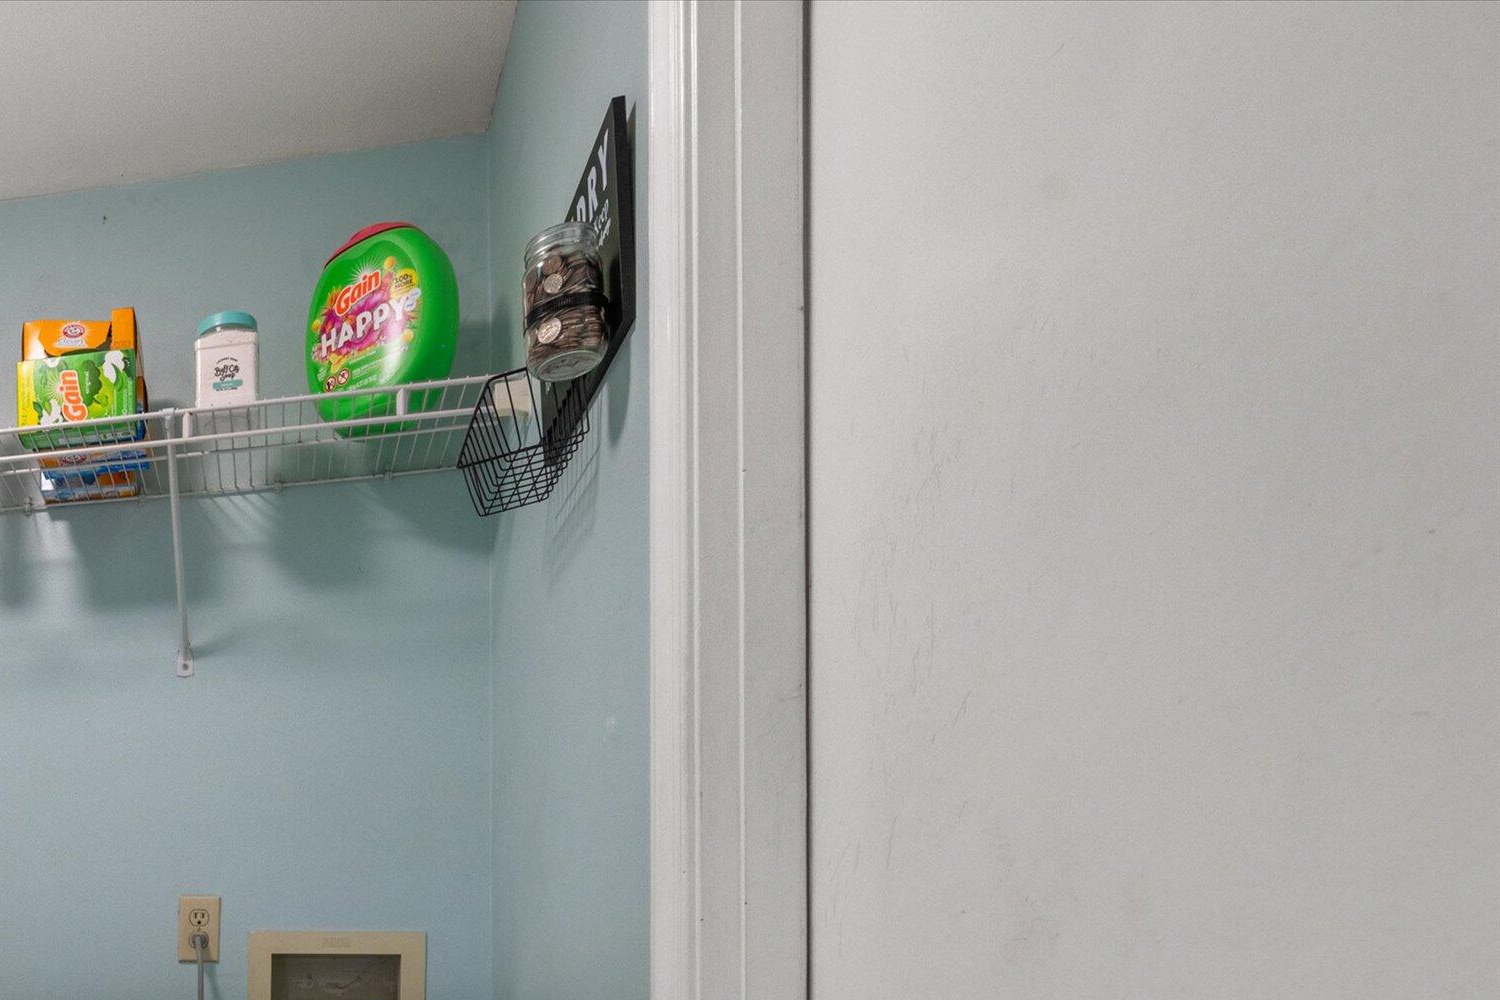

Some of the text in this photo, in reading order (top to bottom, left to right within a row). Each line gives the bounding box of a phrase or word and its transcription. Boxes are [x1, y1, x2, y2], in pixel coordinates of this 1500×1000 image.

[335, 269, 382, 317] Gain
[321, 295, 408, 358] HAPPY
[60, 370, 88, 422] Gain
